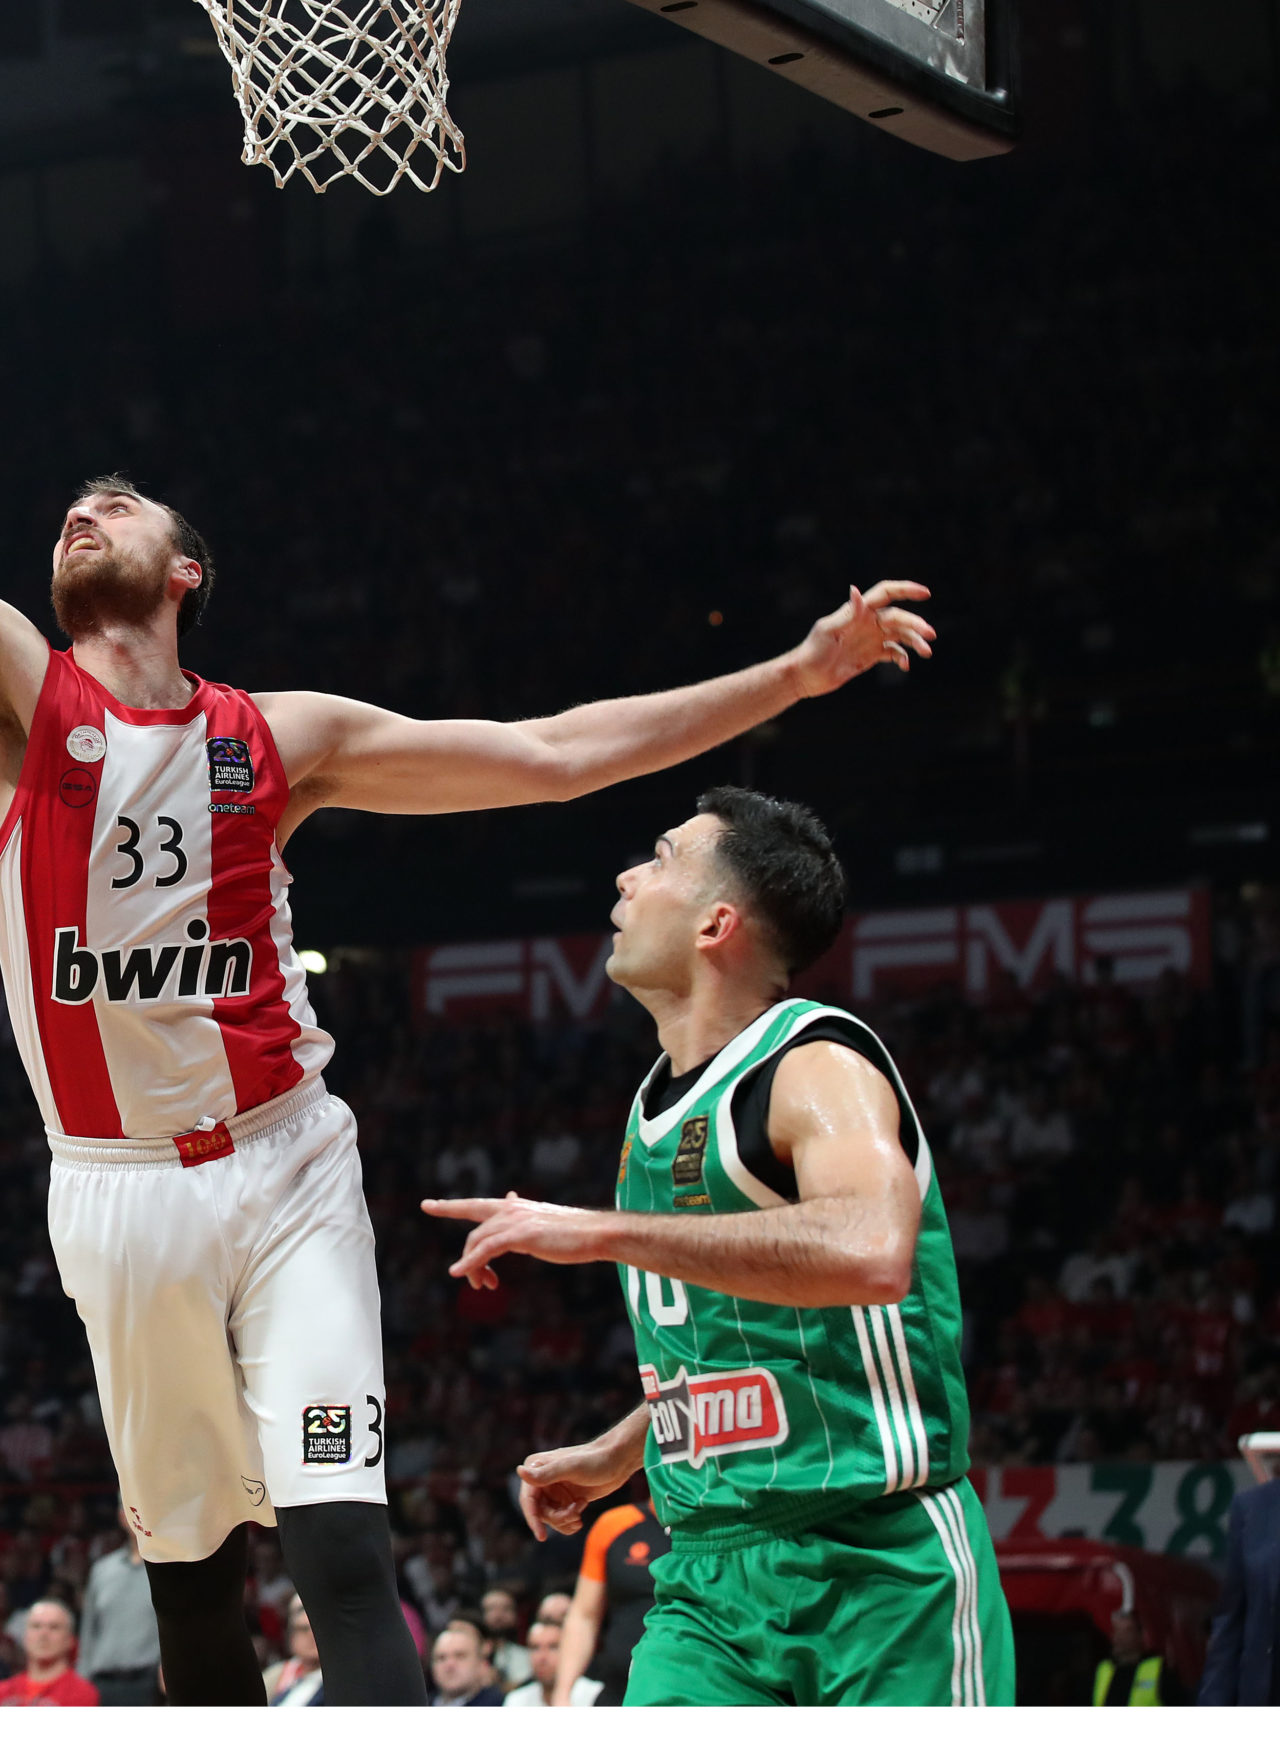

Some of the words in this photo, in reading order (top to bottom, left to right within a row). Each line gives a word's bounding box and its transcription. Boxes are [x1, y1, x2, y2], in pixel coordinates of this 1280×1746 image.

[215, 766, 249, 774] TURKISH
[215, 772, 250, 781] AIRLINES
[215, 779, 250, 787] EuroLeague
[208, 804, 255, 815] oneteam
[111, 816, 188, 889] 33
[853, 891, 1192, 1002] FMS
[53, 918, 252, 1003] bwin
[426, 937, 616, 1020] FM
[308, 1409, 346, 1433] 25
[308, 1452, 347, 1460] EuroLeague
